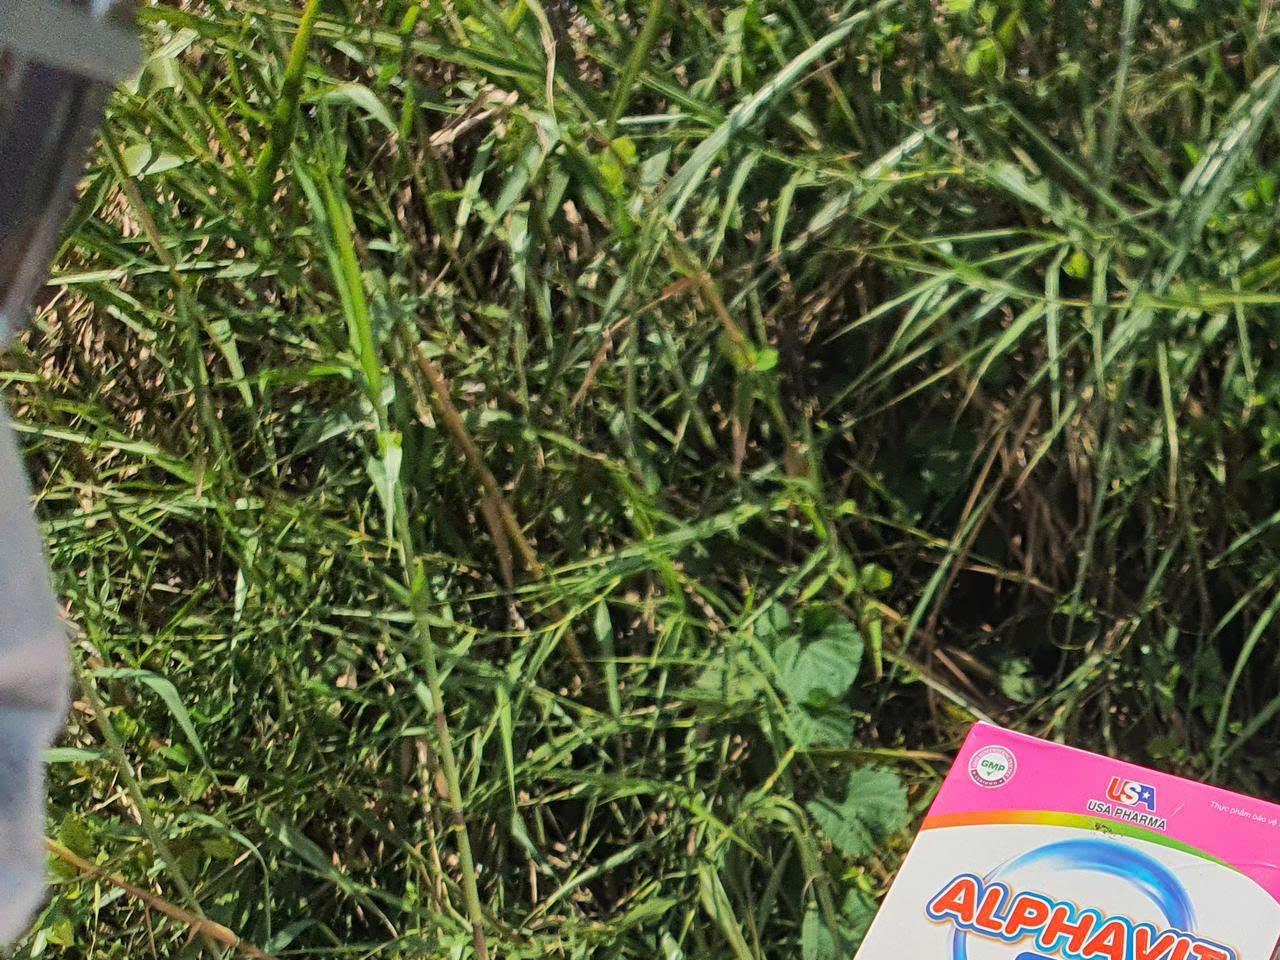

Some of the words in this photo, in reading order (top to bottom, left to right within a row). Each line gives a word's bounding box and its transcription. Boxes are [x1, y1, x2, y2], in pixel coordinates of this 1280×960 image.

[980, 759, 1006, 772] GMP
[1106, 776, 1156, 812] USA
[1087, 800, 1111, 815] USA
[1114, 808, 1166, 830] PHARMA
